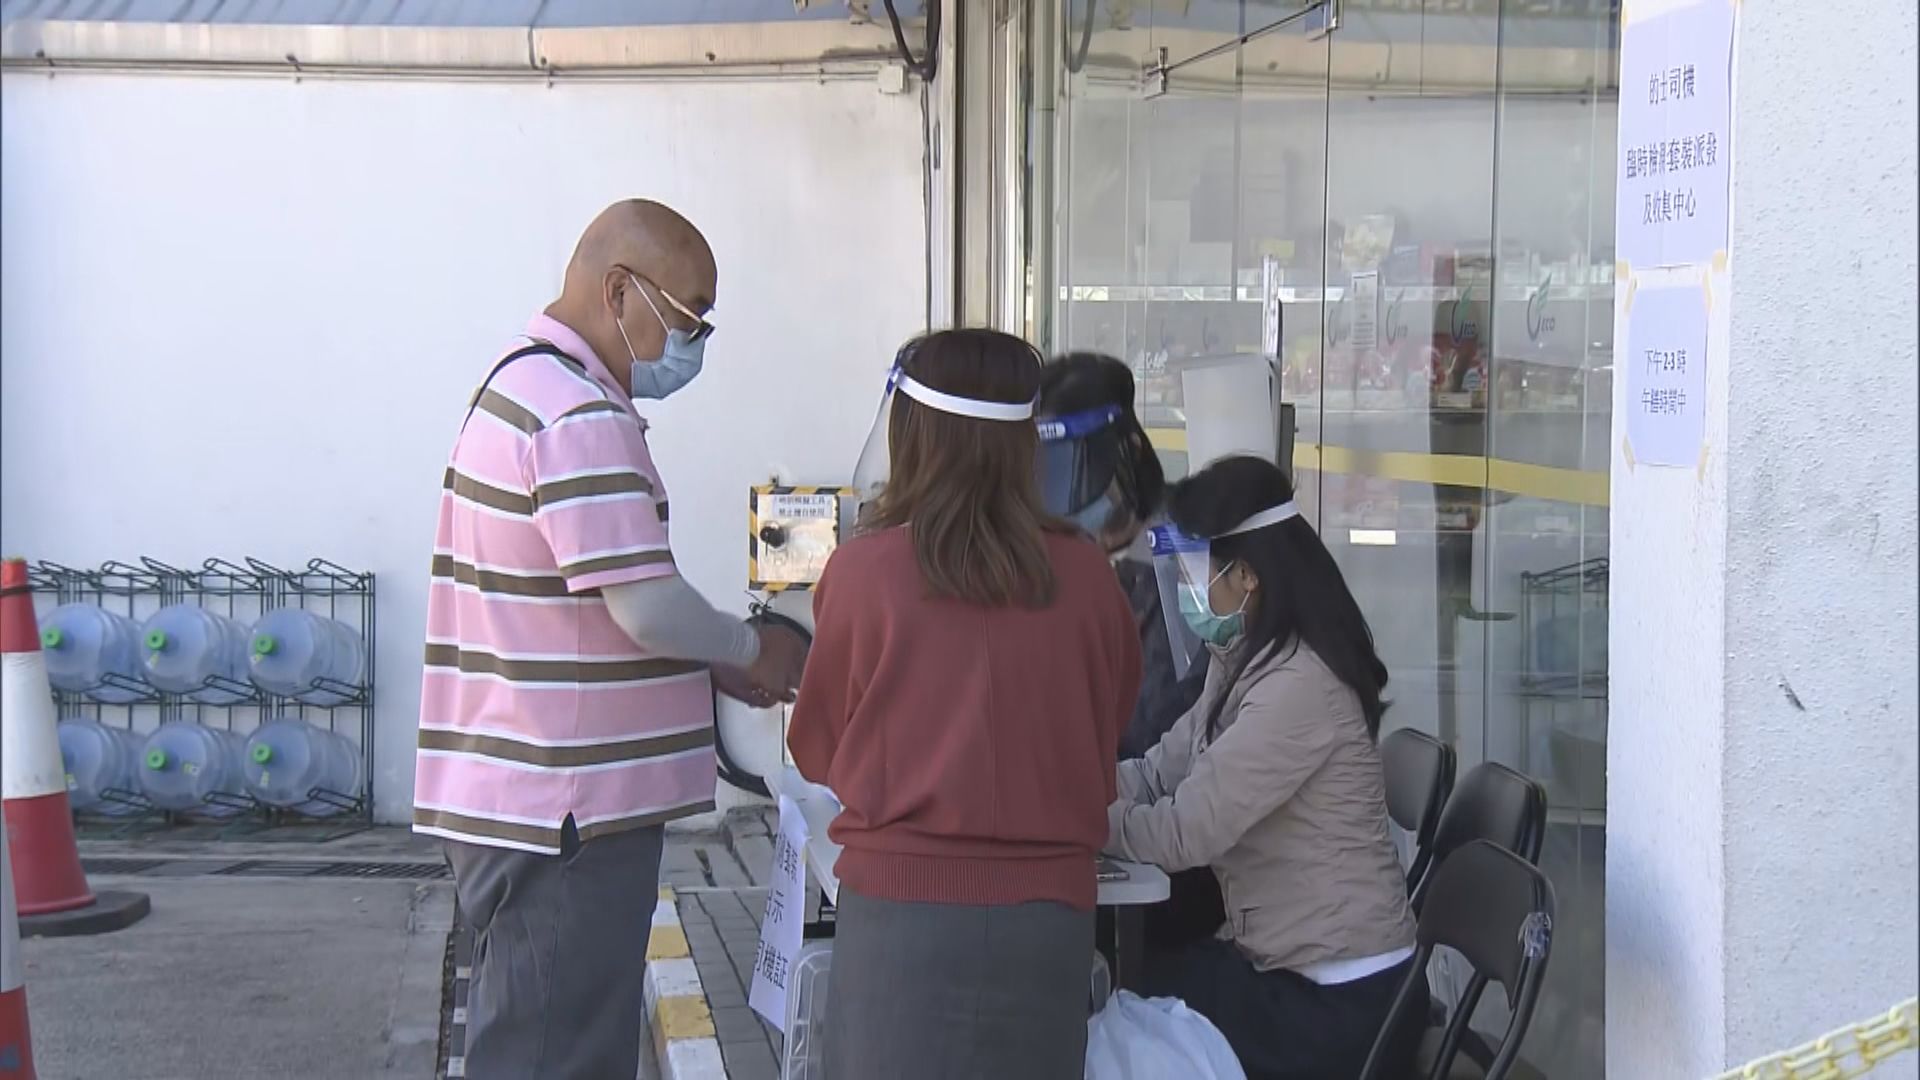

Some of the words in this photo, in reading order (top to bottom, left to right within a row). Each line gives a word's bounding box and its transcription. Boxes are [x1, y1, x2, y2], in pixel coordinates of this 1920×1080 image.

[1649, 64, 1696, 105] 的士司機
[1626, 132, 1717, 178] 臨時檢測套裝派發
[1643, 187, 1696, 224] 及收集中心
[1641, 388, 1687, 415] 午膳時間中
